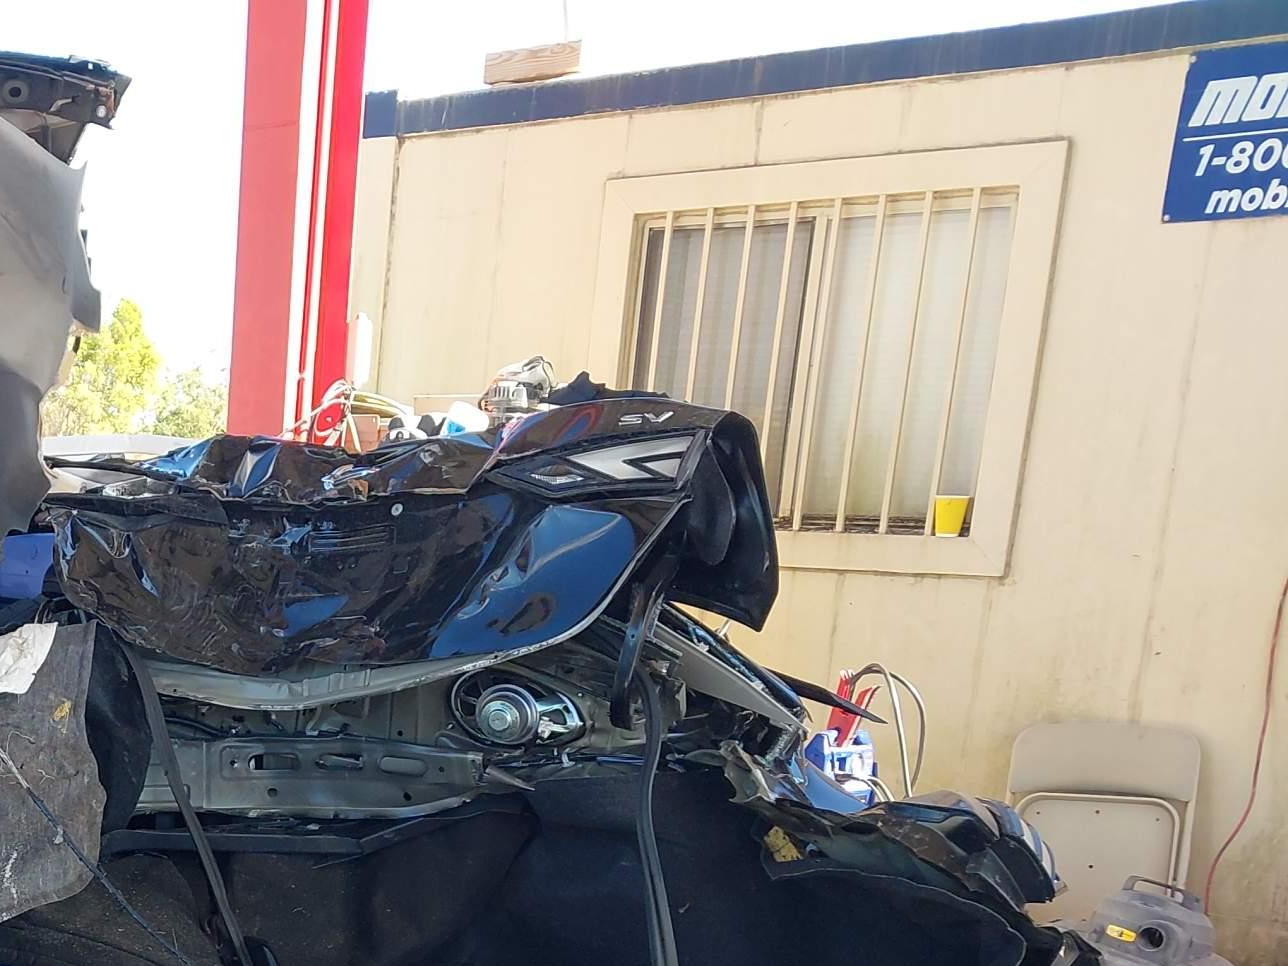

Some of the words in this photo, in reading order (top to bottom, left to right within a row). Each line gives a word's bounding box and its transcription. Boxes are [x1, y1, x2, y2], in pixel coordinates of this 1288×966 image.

[1195, 138, 1288, 177] 1-80
[1204, 178, 1288, 214] mob
[618, 411, 674, 426] SV
